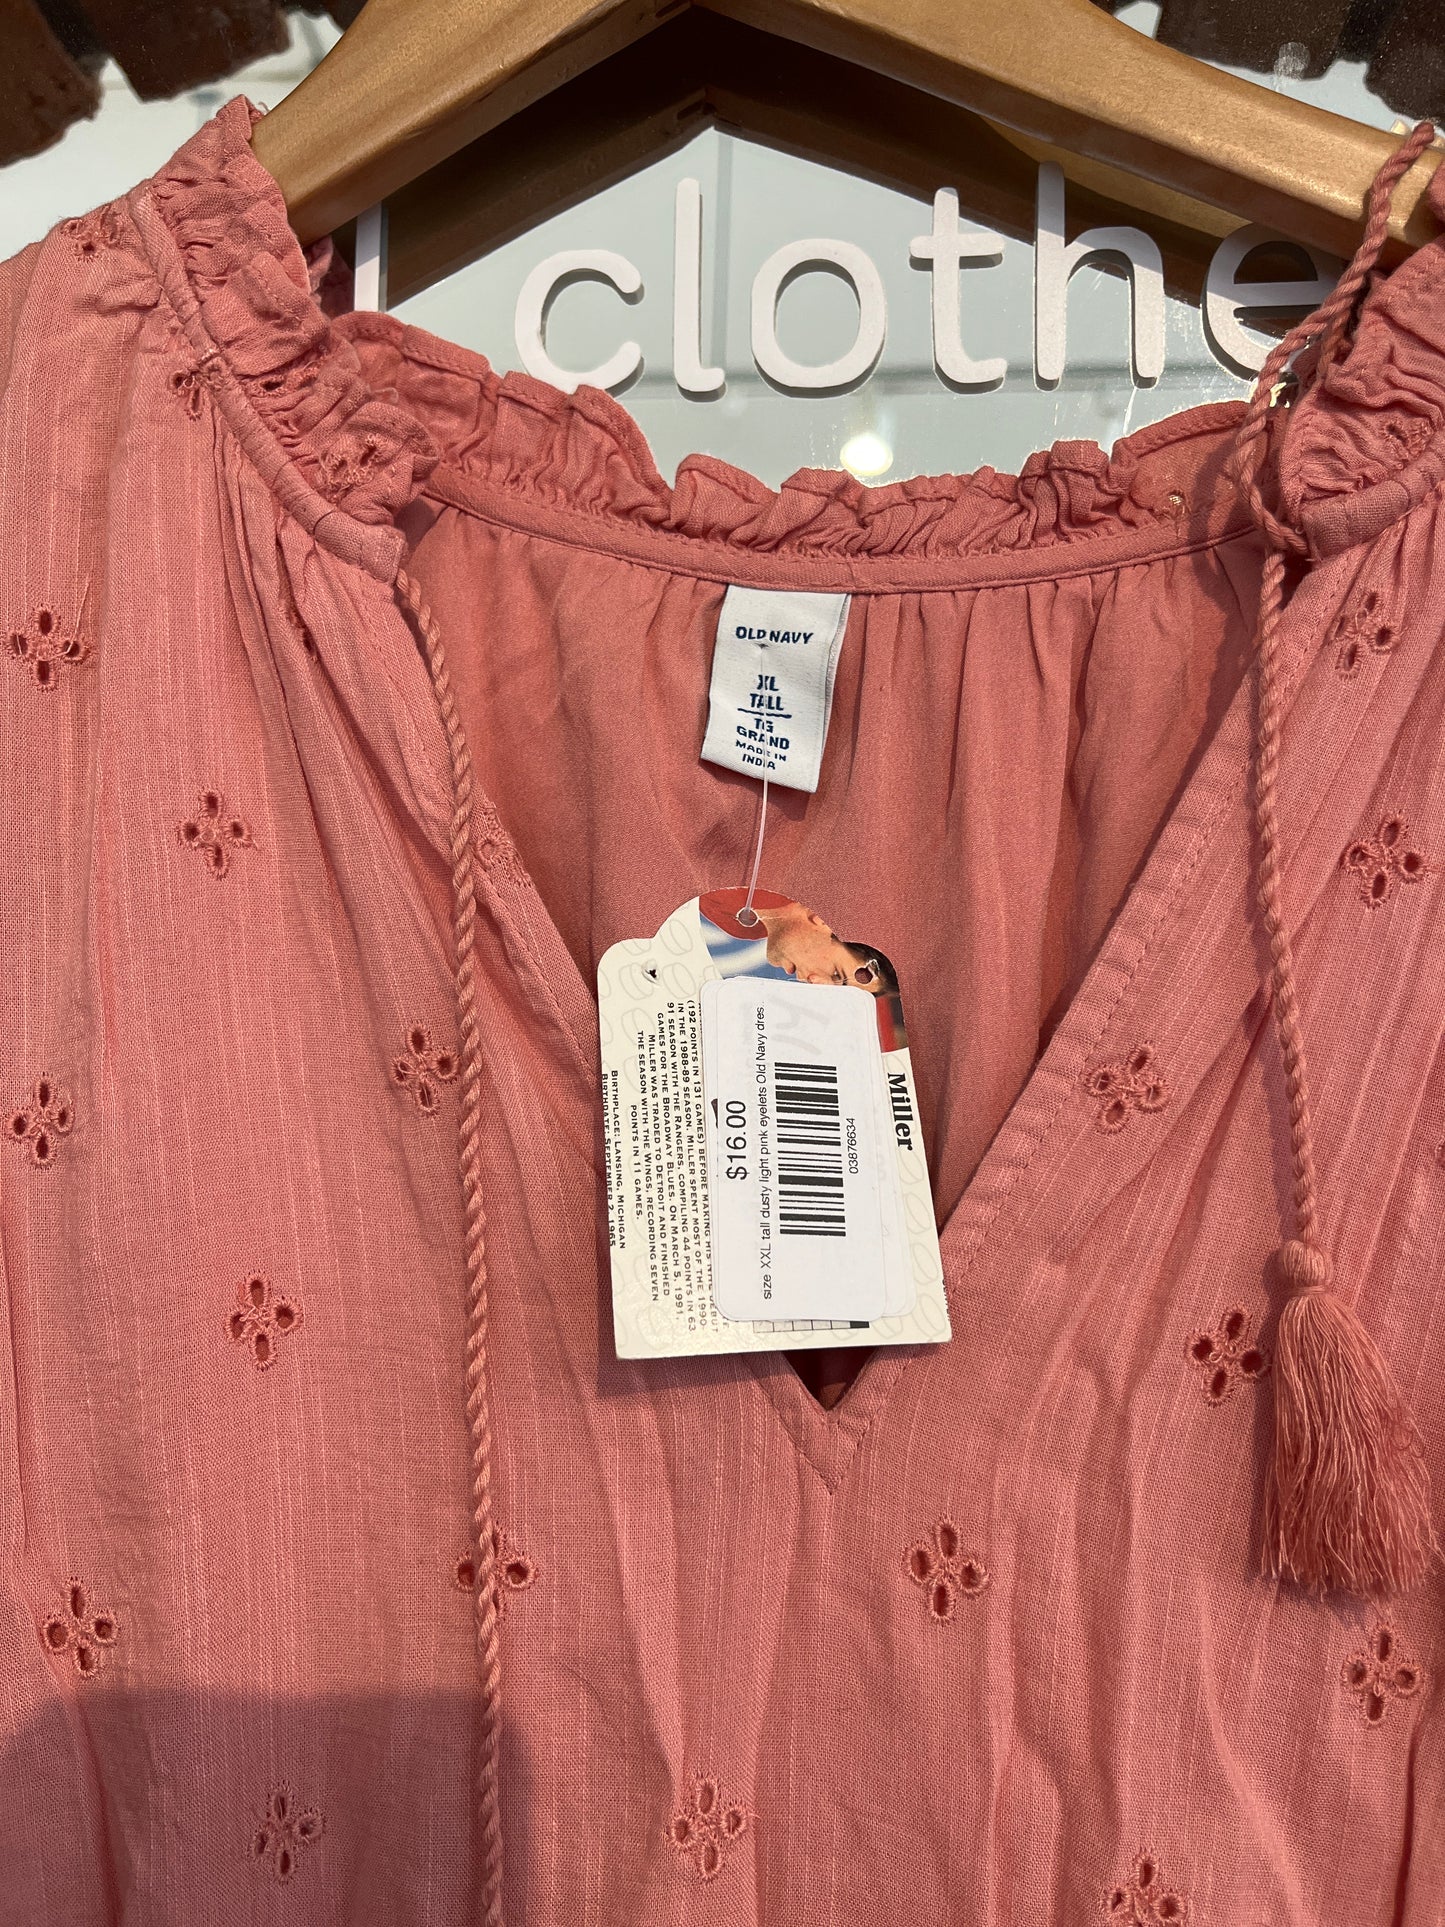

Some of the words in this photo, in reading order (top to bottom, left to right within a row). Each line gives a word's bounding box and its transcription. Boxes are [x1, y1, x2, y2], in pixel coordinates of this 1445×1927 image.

[736, 626, 766, 639] OLD
[769, 630, 814, 644] NAVY
[757, 675, 779, 691] XL
[750, 693, 784, 711] TALL
[736, 726, 790, 750] GRAND
[754, 719, 773, 733] TG
[736, 740, 770, 756] MADE
[742, 754, 776, 770] INDIA
[667, 1002, 674, 1013] 91
[678, 1003, 685, 1012] IN
[657, 1013, 666, 1046] GAMES
[668, 1019, 677, 1057] SEASON
[648, 1035, 656, 1072] MILLER
[690, 1027, 698, 1062] POINTS
[756, 1033, 768, 1060] Navy
[639, 1054, 647, 1094] SEASON
[671, 1062, 679, 1087] WITH
[680, 1041, 690, 1083] 1988-89
[693, 1066, 700, 1076] IN
[756, 1064, 766, 1084] Old
[757, 1087, 770, 1127] eyelets
[888, 1073, 913, 1150] Miller
[631, 1105, 639, 1141] POINTS
[663, 1098, 672, 1156] BROADWAY
[695, 1104, 704, 1144] GAMES)
[633, 1146, 639, 1156] IN
[655, 1148, 661, 1160] TO
[726, 1100, 750, 1180] $16.00
[758, 1130, 770, 1155] pink
[846, 1118, 858, 1174] 03876634
[634, 1162, 641, 1173] 11
[687, 1136, 695, 1175] MILLER
[699, 1149, 707, 1189] BEFORE
[758, 1158, 772, 1182] light
[656, 1166, 664, 1211] DETROIT
[667, 1162, 675, 1201] BLUES.
[690, 1179, 698, 1213] SPENT
[669, 1206, 677, 1221] ON
[678, 1174, 688, 1232] COMPILING
[702, 1194, 710, 1236] MAKING
[759, 1186, 772, 1218] dusty
[647, 1197, 656, 1260] RECORDING
[760, 1222, 770, 1240] tall
[671, 1227, 679, 1266] MARCH
[683, 1237, 690, 1251] 44
[695, 1251, 702, 1264] OF
[760, 1243, 771, 1269] XXL
[651, 1265, 659, 1301] SEVEN
[661, 1243, 669, 1296] FINISHED
[684, 1256, 693, 1295] POINTS
[762, 1274, 772, 1300] size
[687, 1301, 693, 1311] IN
[688, 1317, 695, 1331] 63
